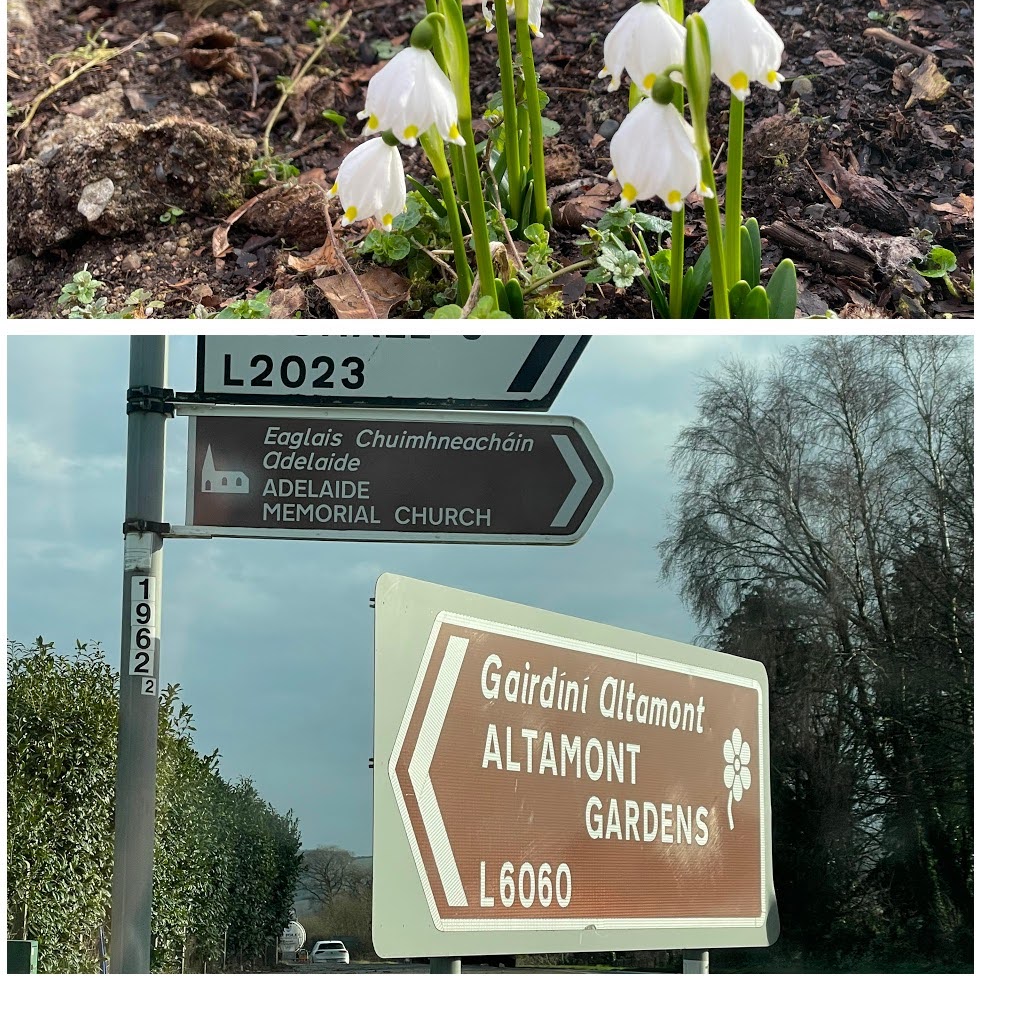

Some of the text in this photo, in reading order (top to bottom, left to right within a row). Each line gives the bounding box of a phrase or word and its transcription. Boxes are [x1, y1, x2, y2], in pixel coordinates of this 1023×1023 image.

[223, 353, 366, 389] L2023
[263, 426, 534, 452] Eaglais Chuimhneacháin
[262, 478, 371, 500] ADELAIDE
[262, 503, 491, 527] MEMORIAL CHURCH
[134, 578, 151, 673] 1962
[145, 679, 154, 693] 2
[480, 653, 589, 714] Gairdíní
[481, 723, 641, 785] ALTAMONT
[585, 796, 709, 846] GARDENS
[479, 861, 572, 908] L6060
